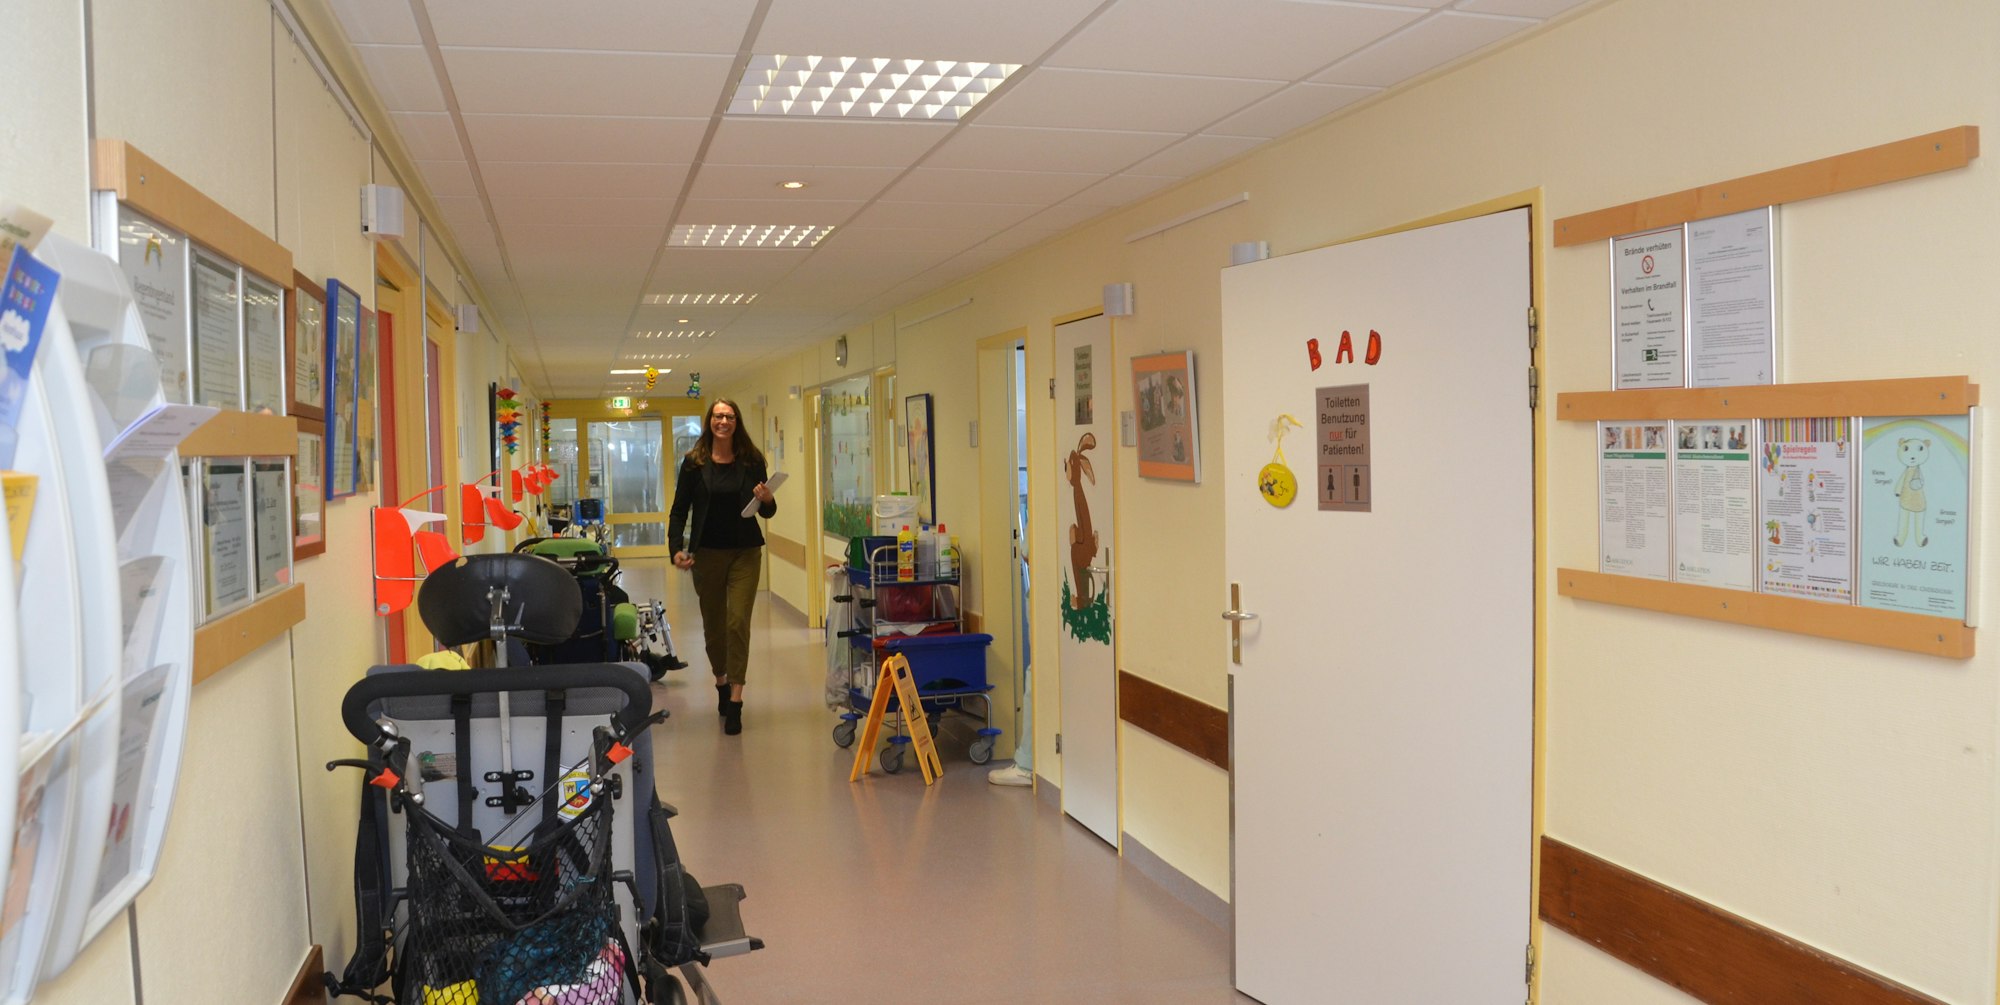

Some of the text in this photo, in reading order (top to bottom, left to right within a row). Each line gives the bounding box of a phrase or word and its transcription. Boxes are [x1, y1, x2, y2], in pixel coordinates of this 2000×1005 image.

[1624, 242, 1672, 256] Brände verhüten
[1621, 286, 1644, 295] Verhalten
[1653, 281, 1677, 290] Brandfall
[1306, 329, 1382, 372] BAD
[1325, 397, 1360, 409] Toiletten
[1321, 413, 1365, 426] Benutzung
[1329, 428, 1357, 441] nur für
[1322, 444, 1364, 456] Patienten!
[1783, 445, 1817, 454] Spielregeln
[1872, 556, 1955, 573] WIR HABEN ZEIT.
